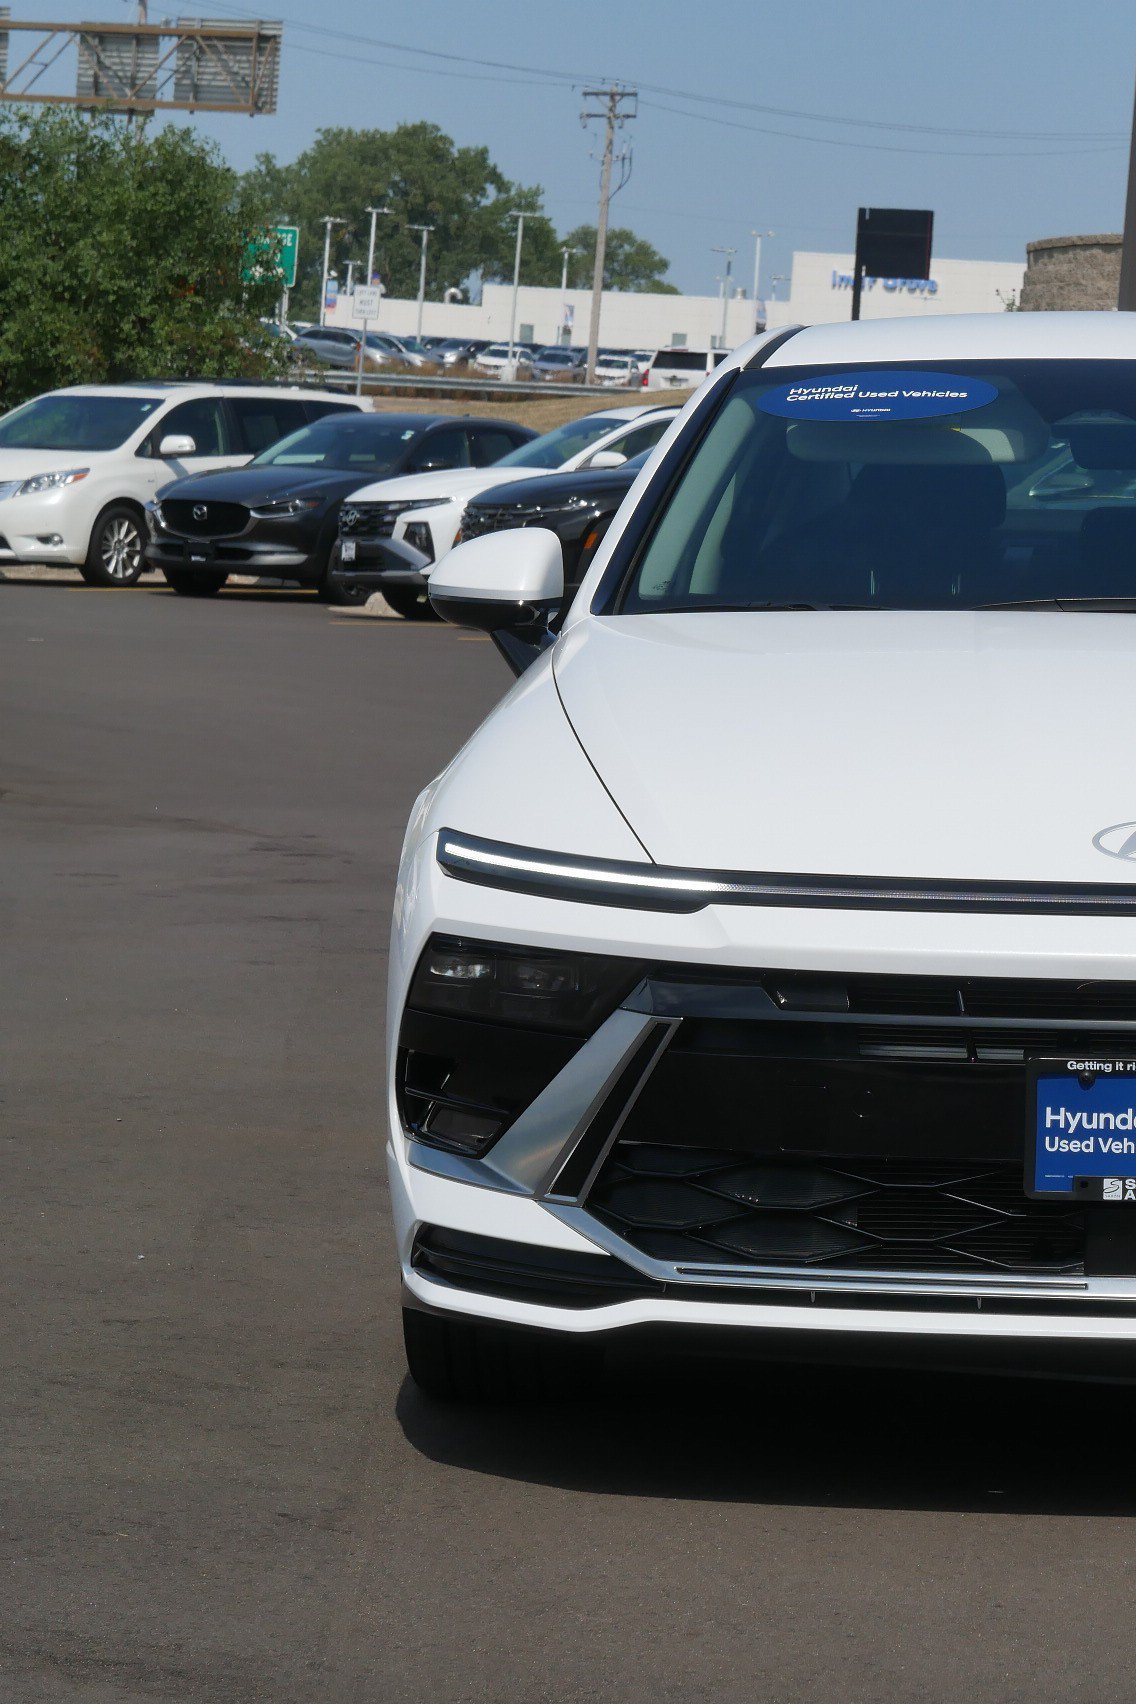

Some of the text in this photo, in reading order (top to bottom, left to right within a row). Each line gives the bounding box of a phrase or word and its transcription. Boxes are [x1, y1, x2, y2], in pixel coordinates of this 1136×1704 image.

[831, 270, 877, 290] Inr
[790, 385, 858, 394] Hyundai
[787, 391, 854, 402] Certified
[1067, 1061, 1112, 1073] Getting
[1115, 1062, 1124, 1071] it
[1045, 1137, 1094, 1152] Used
